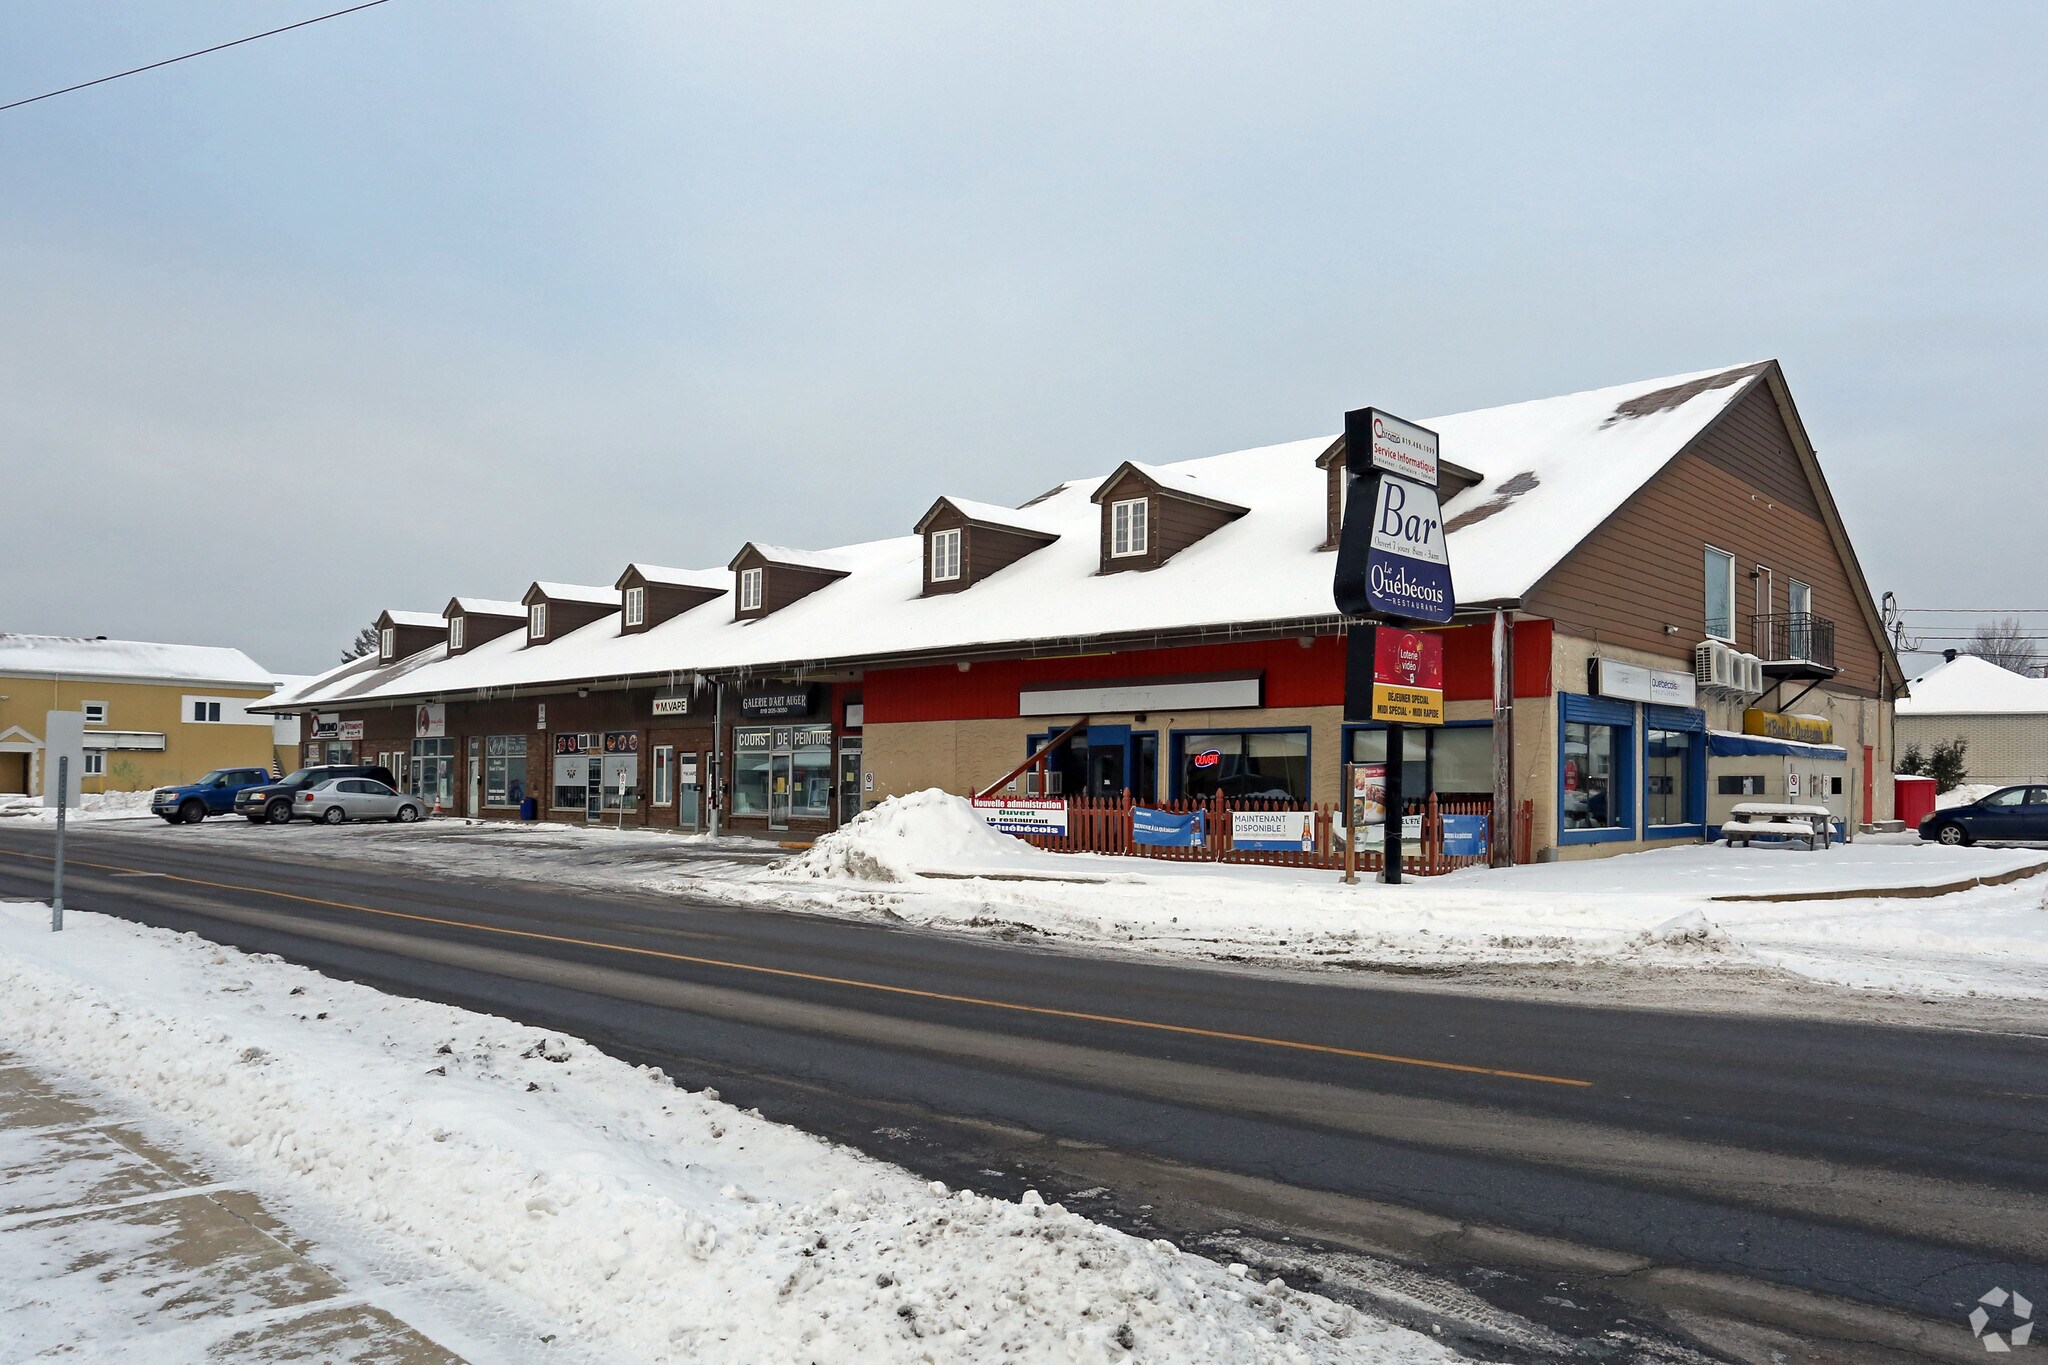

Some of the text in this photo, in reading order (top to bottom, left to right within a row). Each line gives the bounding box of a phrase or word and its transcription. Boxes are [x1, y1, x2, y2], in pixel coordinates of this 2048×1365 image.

[1374, 442, 1436, 474] Service Informatique
[1378, 480, 1437, 544] Bar
[1374, 536, 1392, 549] Ouvert
[1397, 543, 1410, 554] jours
[1383, 561, 1393, 575] Le
[1371, 564, 1444, 604] Québécois
[1392, 598, 1438, 613] RESTAURANT
[1400, 649, 1418, 660] Loterie
[1401, 660, 1417, 671] vidéo
[742, 697, 768, 709] GALERIE
[769, 696, 785, 706] D'ART
[1388, 690, 1429, 704] DÉJEUNER SPÉCIAL
[1377, 703, 1439, 718] MIDI SPÉCIAL MIDI RAPIDE
[739, 731, 831, 746] COURS DE PEINTURE
[1195, 754, 1219, 765] OUVERT
[974, 799, 1062, 809] Nouvelle administration
[999, 816, 1048, 824] restaurant
[1234, 815, 1287, 823] MAINTENANT
[1235, 824, 1281, 832] DISPONIBLE
